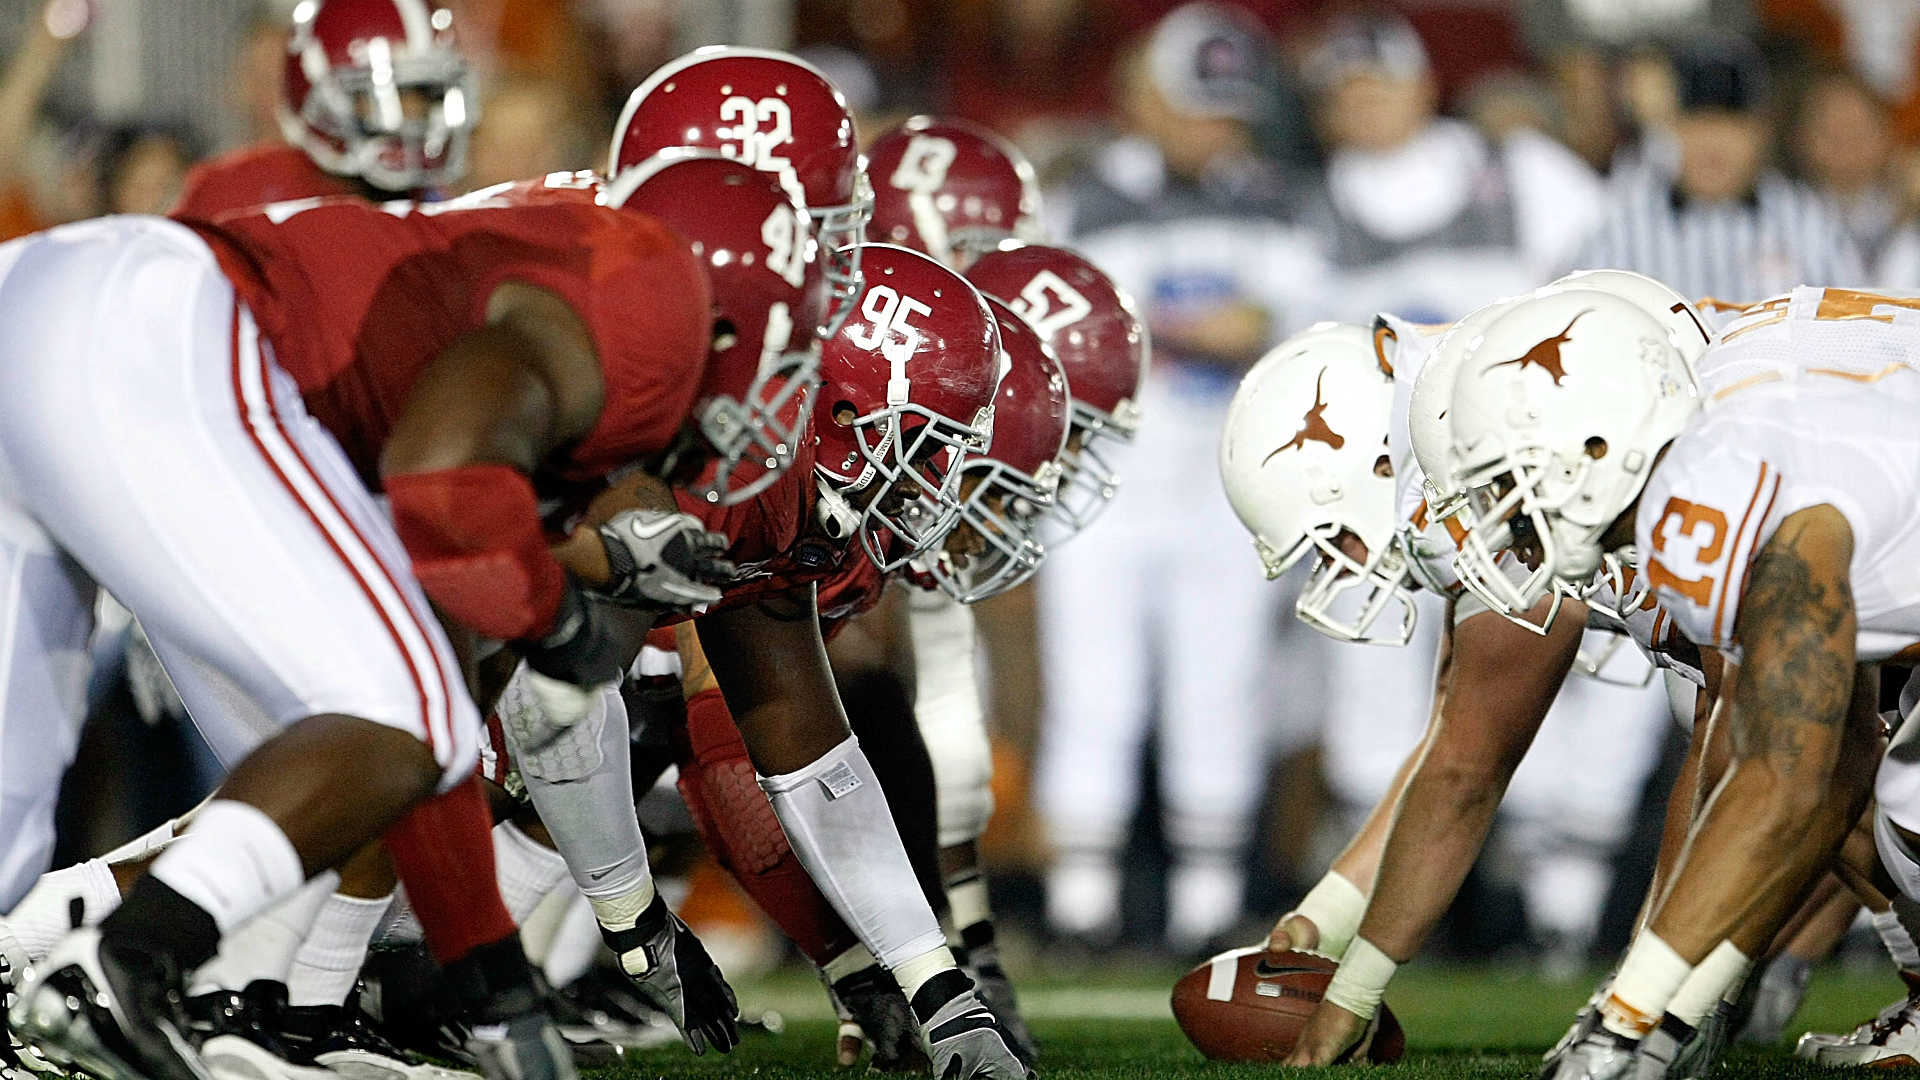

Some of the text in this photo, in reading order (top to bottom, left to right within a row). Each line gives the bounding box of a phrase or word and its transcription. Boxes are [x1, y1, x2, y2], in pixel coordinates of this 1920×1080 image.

[720, 96, 792, 171] 32
[861, 285, 932, 361] 95
[856, 471, 874, 488] TIDE
